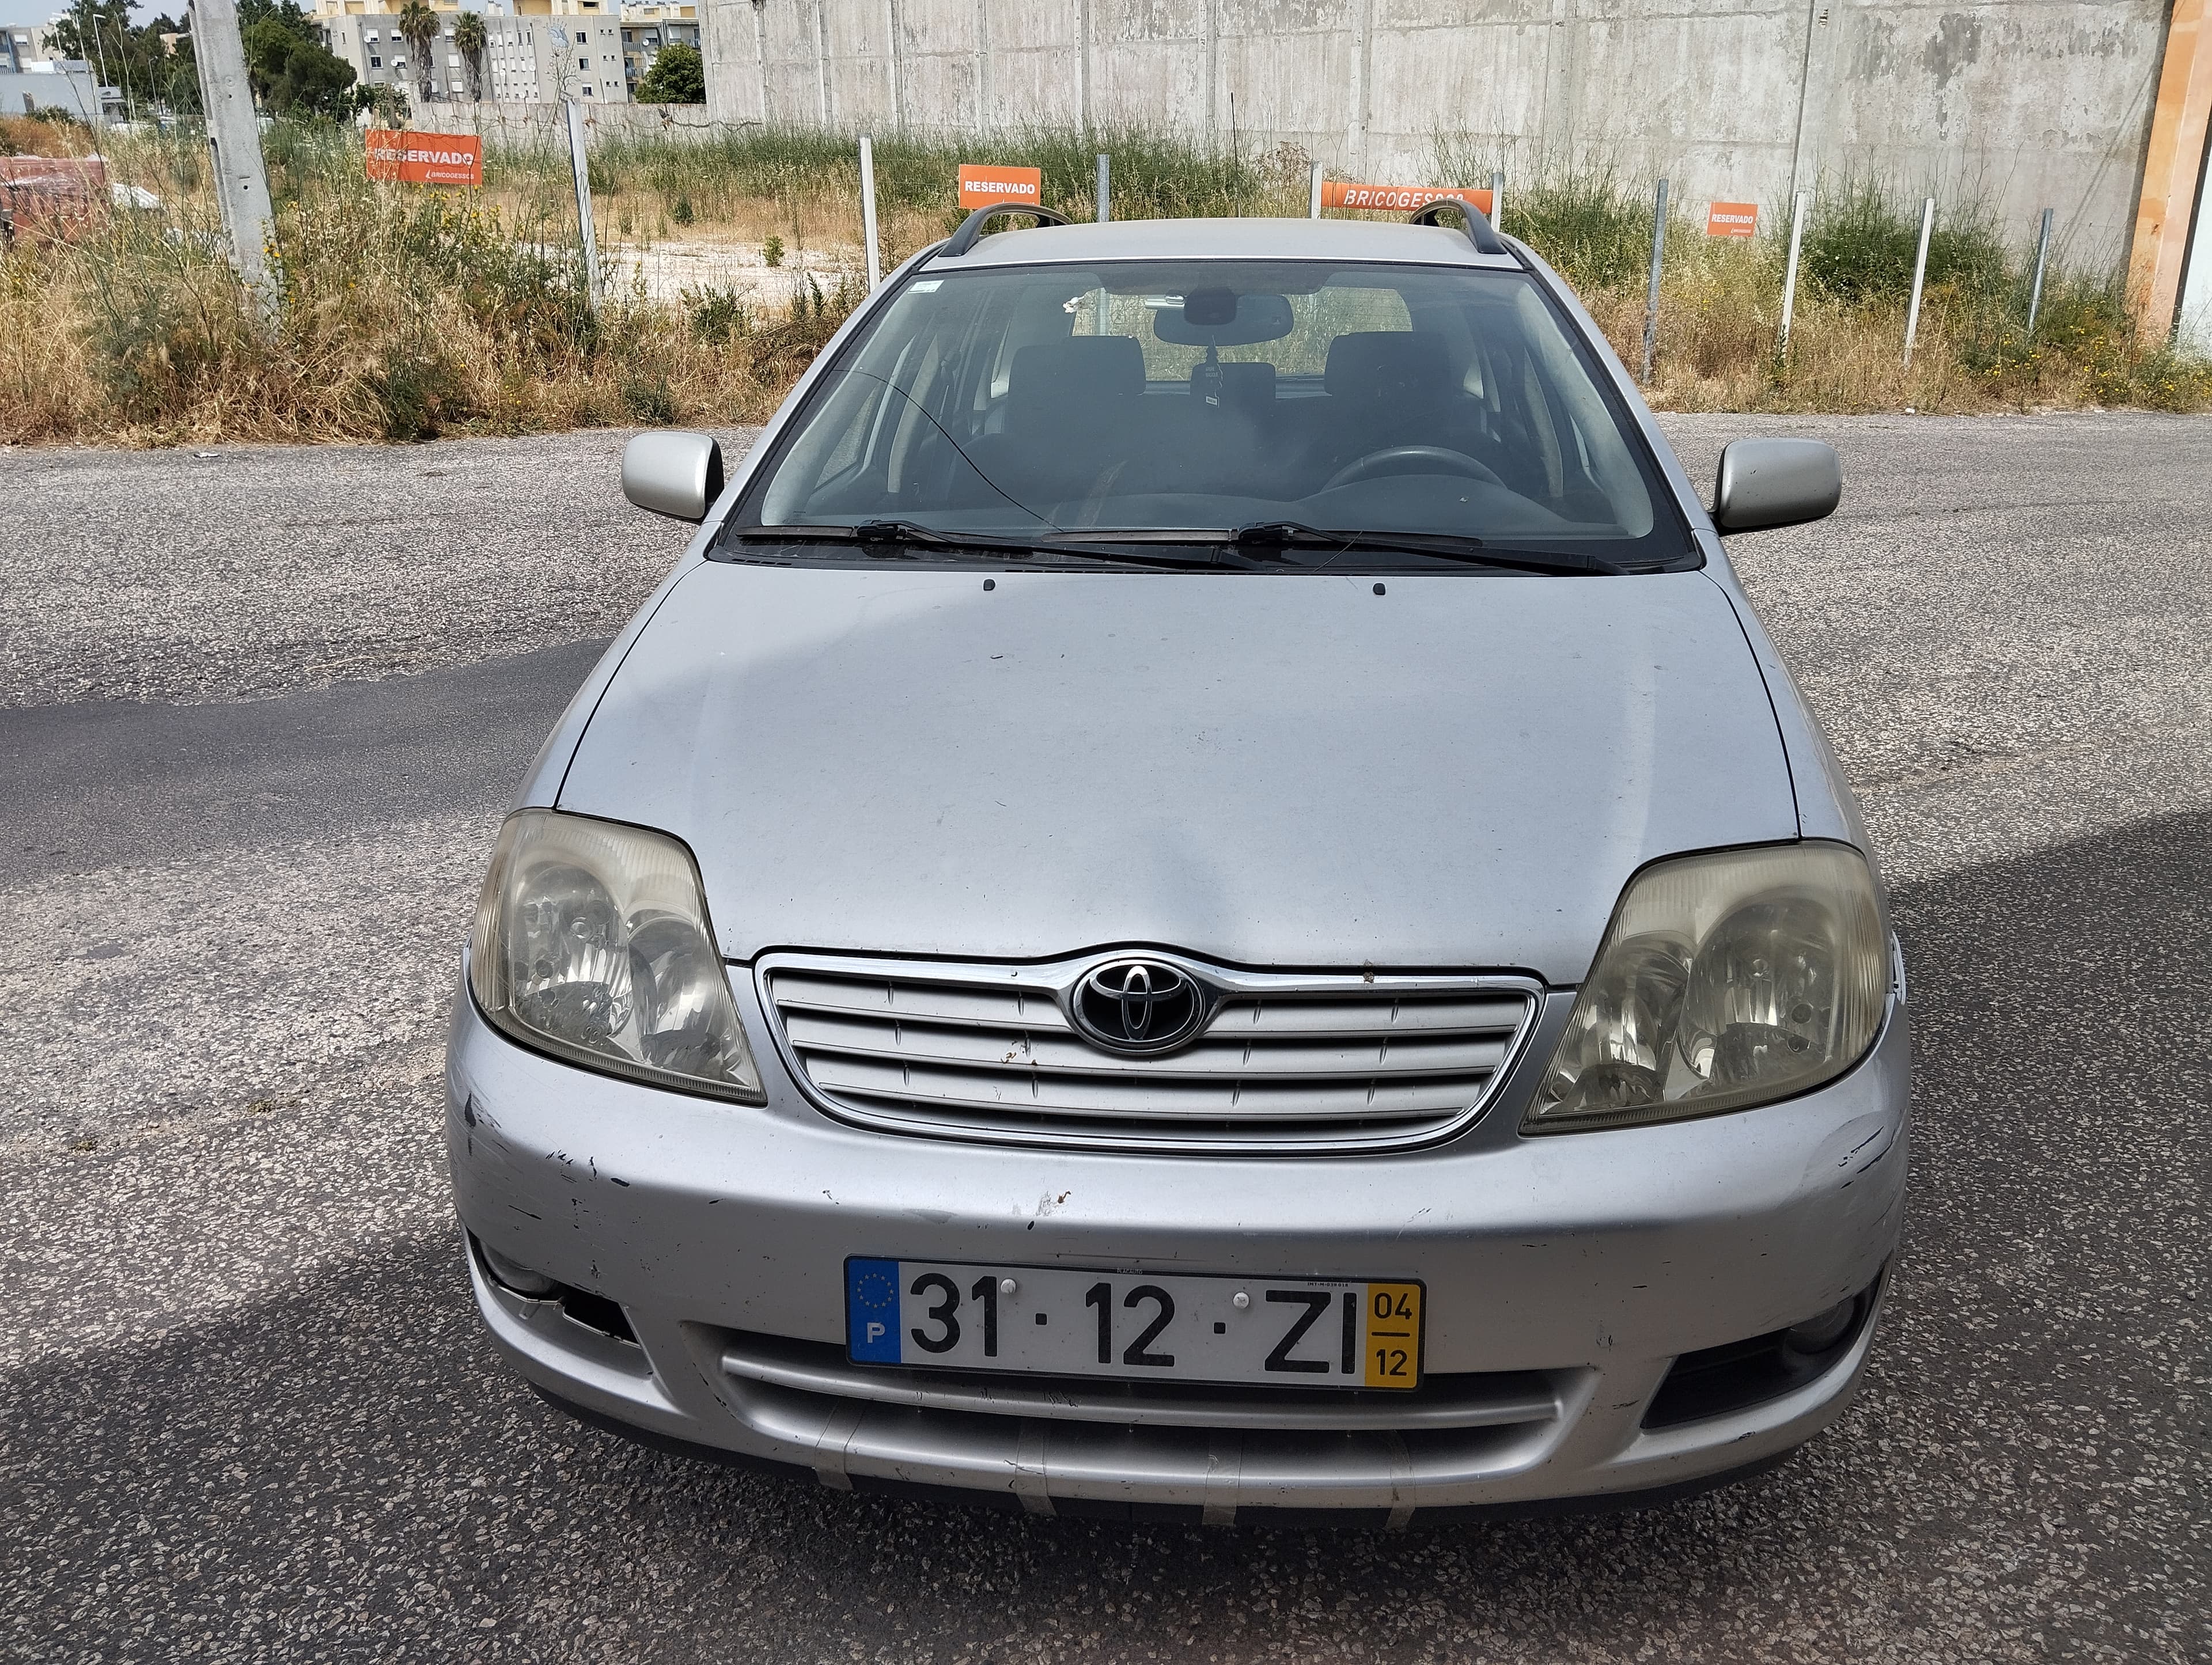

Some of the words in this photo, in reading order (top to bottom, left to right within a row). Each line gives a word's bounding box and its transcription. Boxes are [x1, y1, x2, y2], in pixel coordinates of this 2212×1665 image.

[375, 148, 474, 165] RESERVADO
[965, 181, 1035, 194] RESERVADO
[1711, 214, 1753, 224] RESERVADO
[1374, 1292, 1412, 1320] 04
[866, 1322, 886, 1344] P
[910, 1272, 998, 1357] 31
[1085, 1282, 1175, 1368] 12
[1264, 1289, 1358, 1374] ZI
[1376, 1349, 1407, 1377] 12
